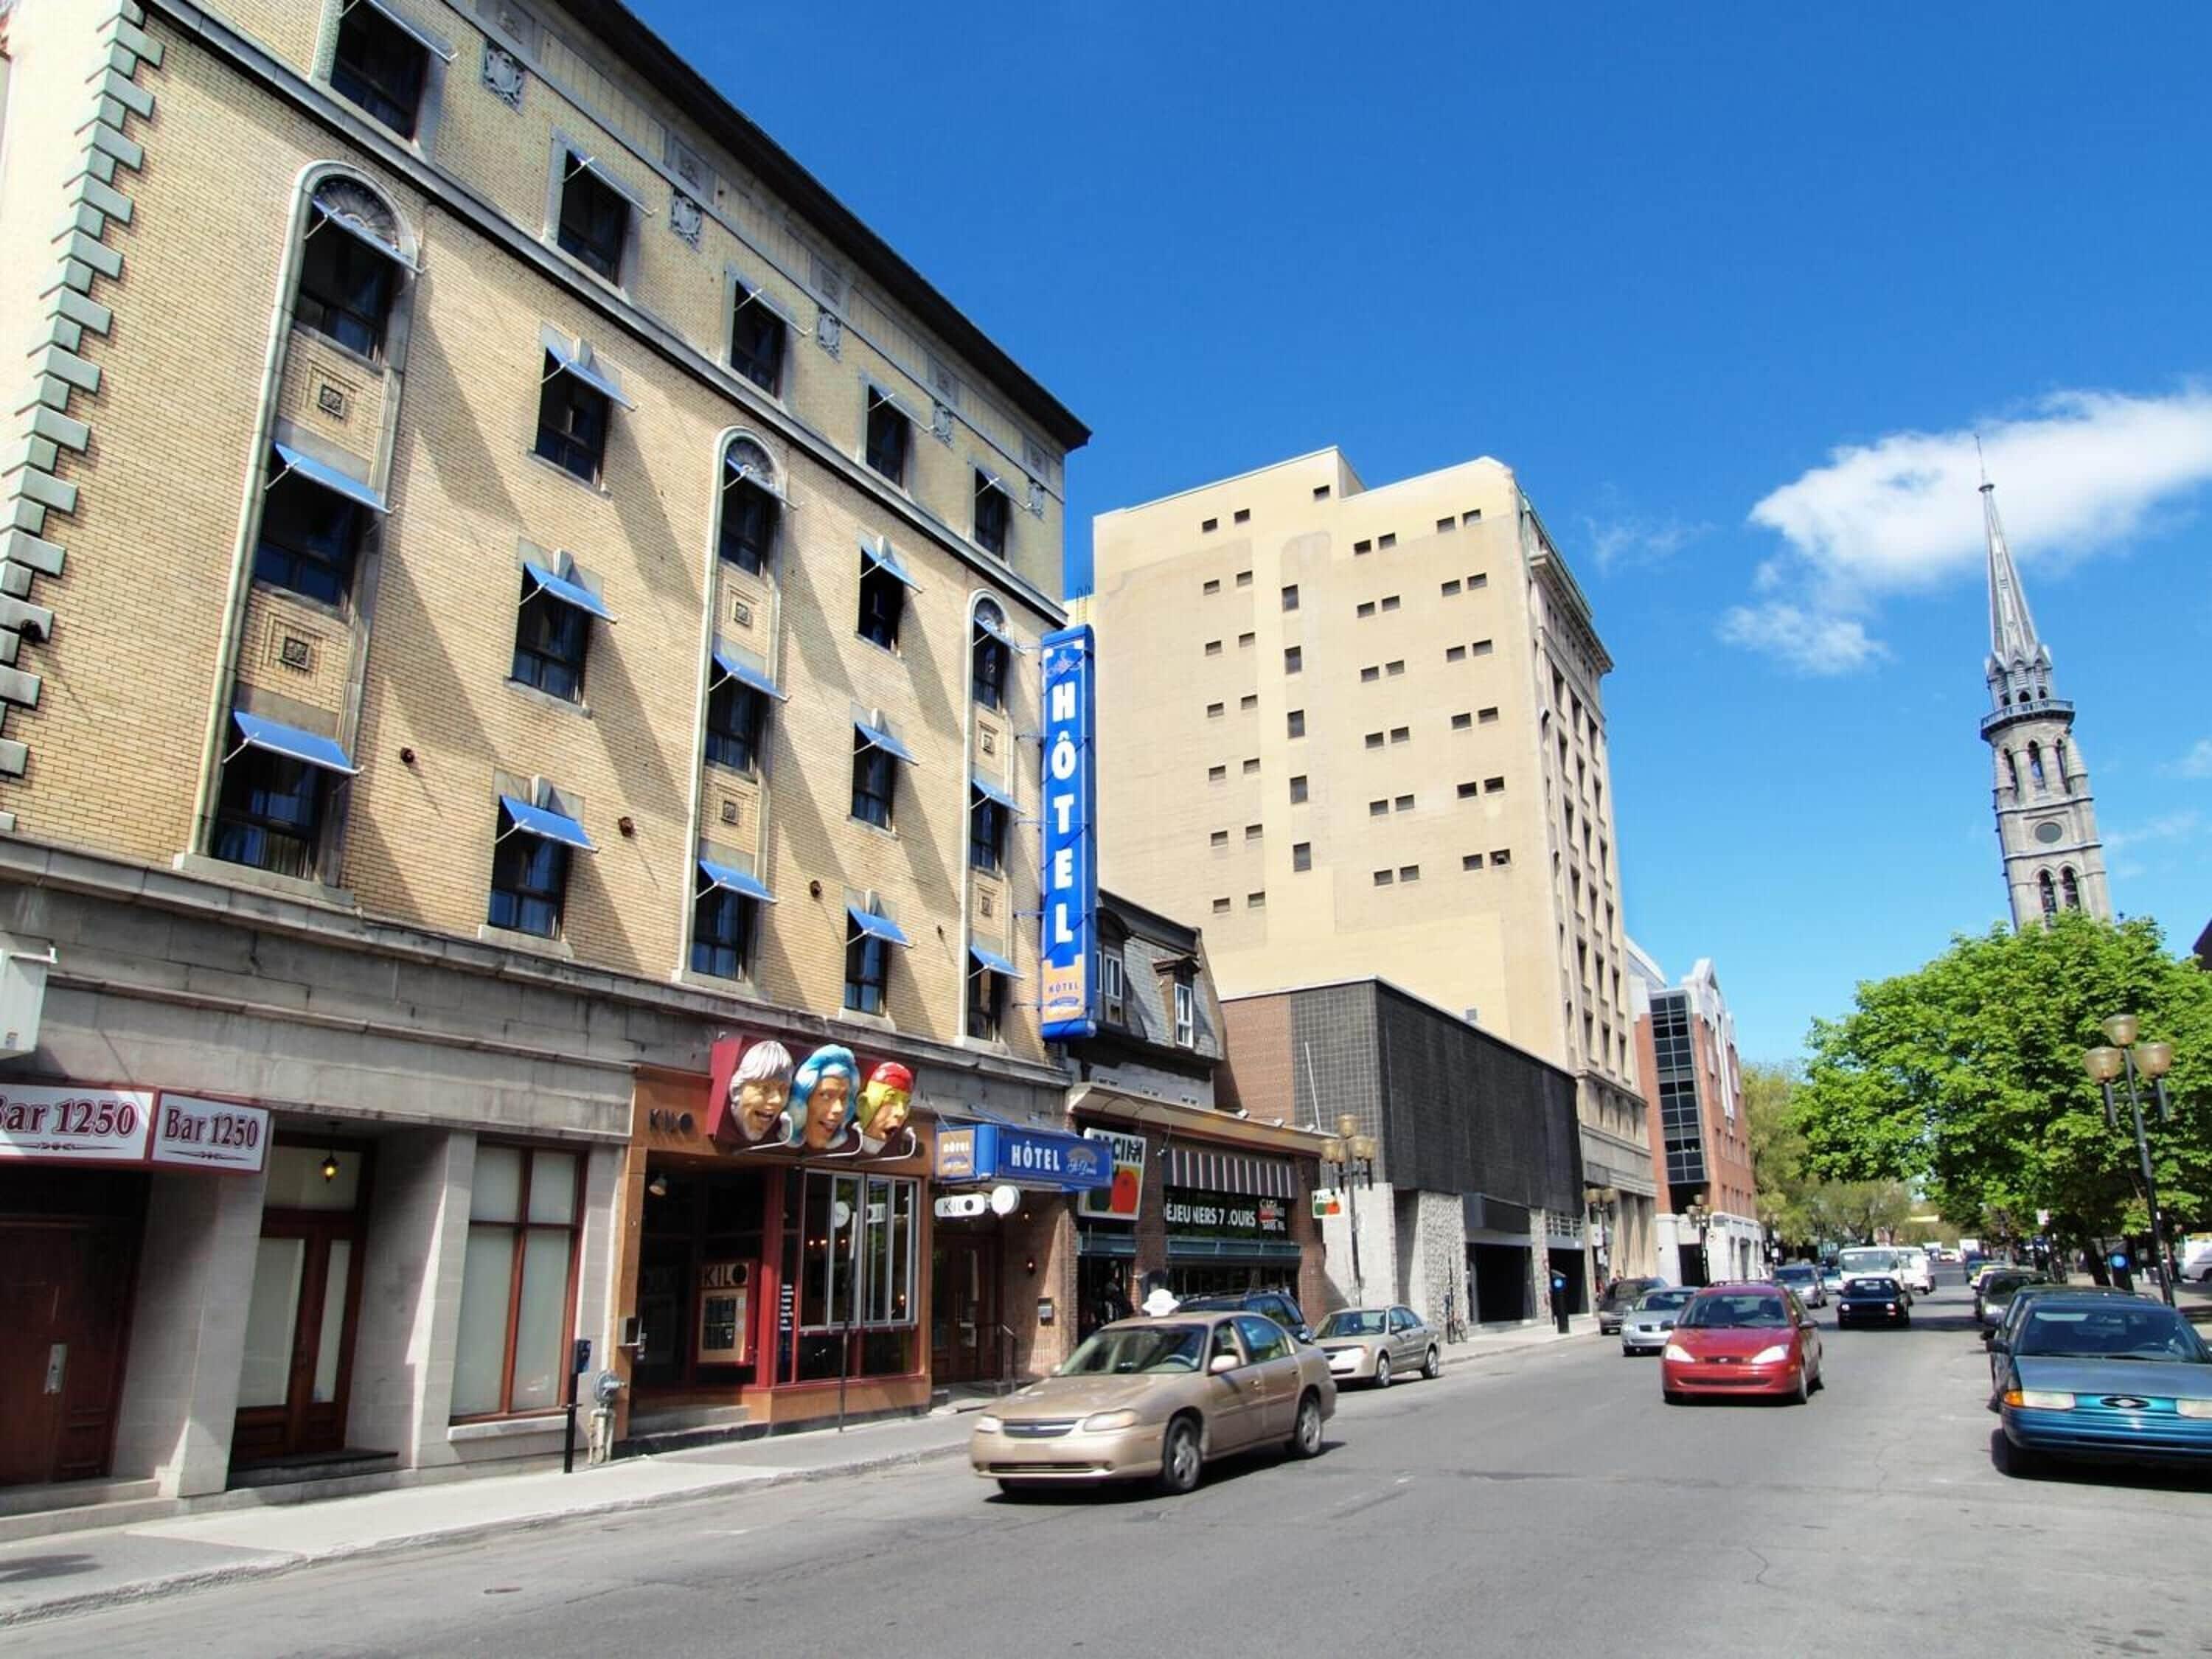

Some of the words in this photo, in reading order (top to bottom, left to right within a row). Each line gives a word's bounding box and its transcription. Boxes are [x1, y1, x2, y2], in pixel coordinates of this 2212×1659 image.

[1051, 681, 1077, 944] HÔTEL
[52, 1098, 139, 1138] 1250
[164, 1105, 207, 1143] Bar
[210, 1110, 259, 1150] 1250
[1011, 1139, 1060, 1172] HÔTEL
[1227, 1208, 1256, 1228] OURS
[703, 1264, 747, 1286] KILO
